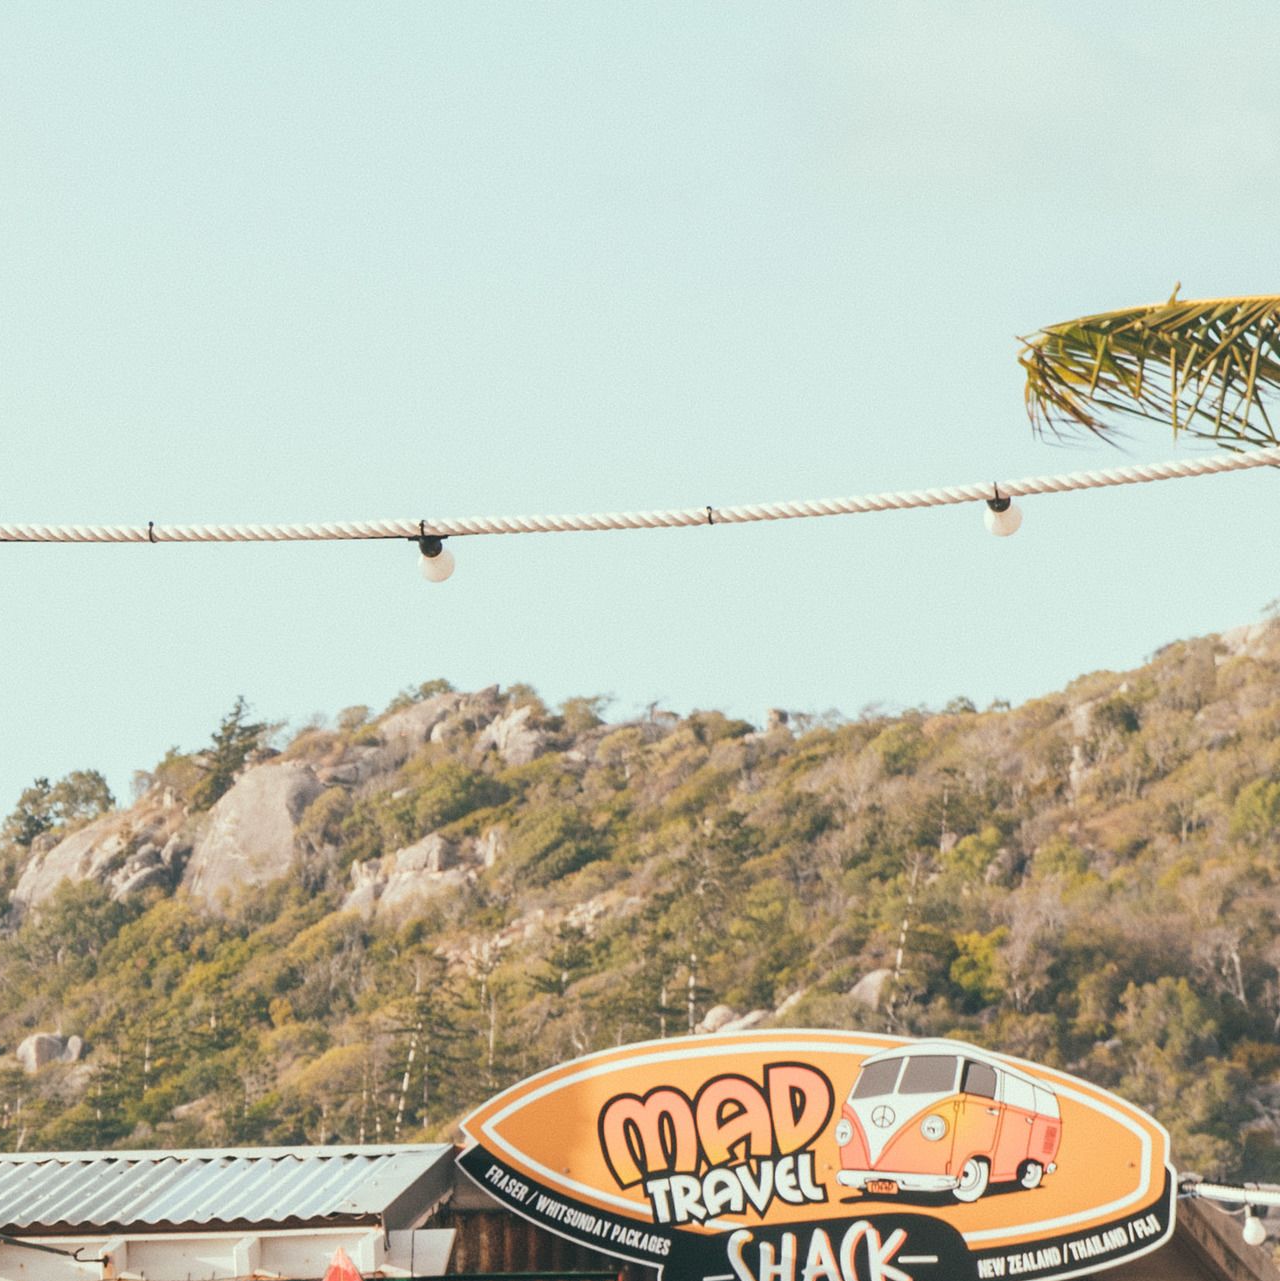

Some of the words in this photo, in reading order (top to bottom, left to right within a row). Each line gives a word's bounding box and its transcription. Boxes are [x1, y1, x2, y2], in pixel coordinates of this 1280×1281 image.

[598, 1061, 835, 1190] MAD
[485, 1165, 529, 1204] FRASER
[536, 1195, 611, 1237] WHITSUNDAY
[611, 1226, 671, 1255] PACKAGES
[646, 1153, 826, 1224] TRAVEL
[977, 1257, 1005, 1279] NEW
[1007, 1246, 1062, 1275] ZEALAND
[1068, 1227, 1128, 1261] THAILAND
[1133, 1213, 1161, 1239] FIJI
